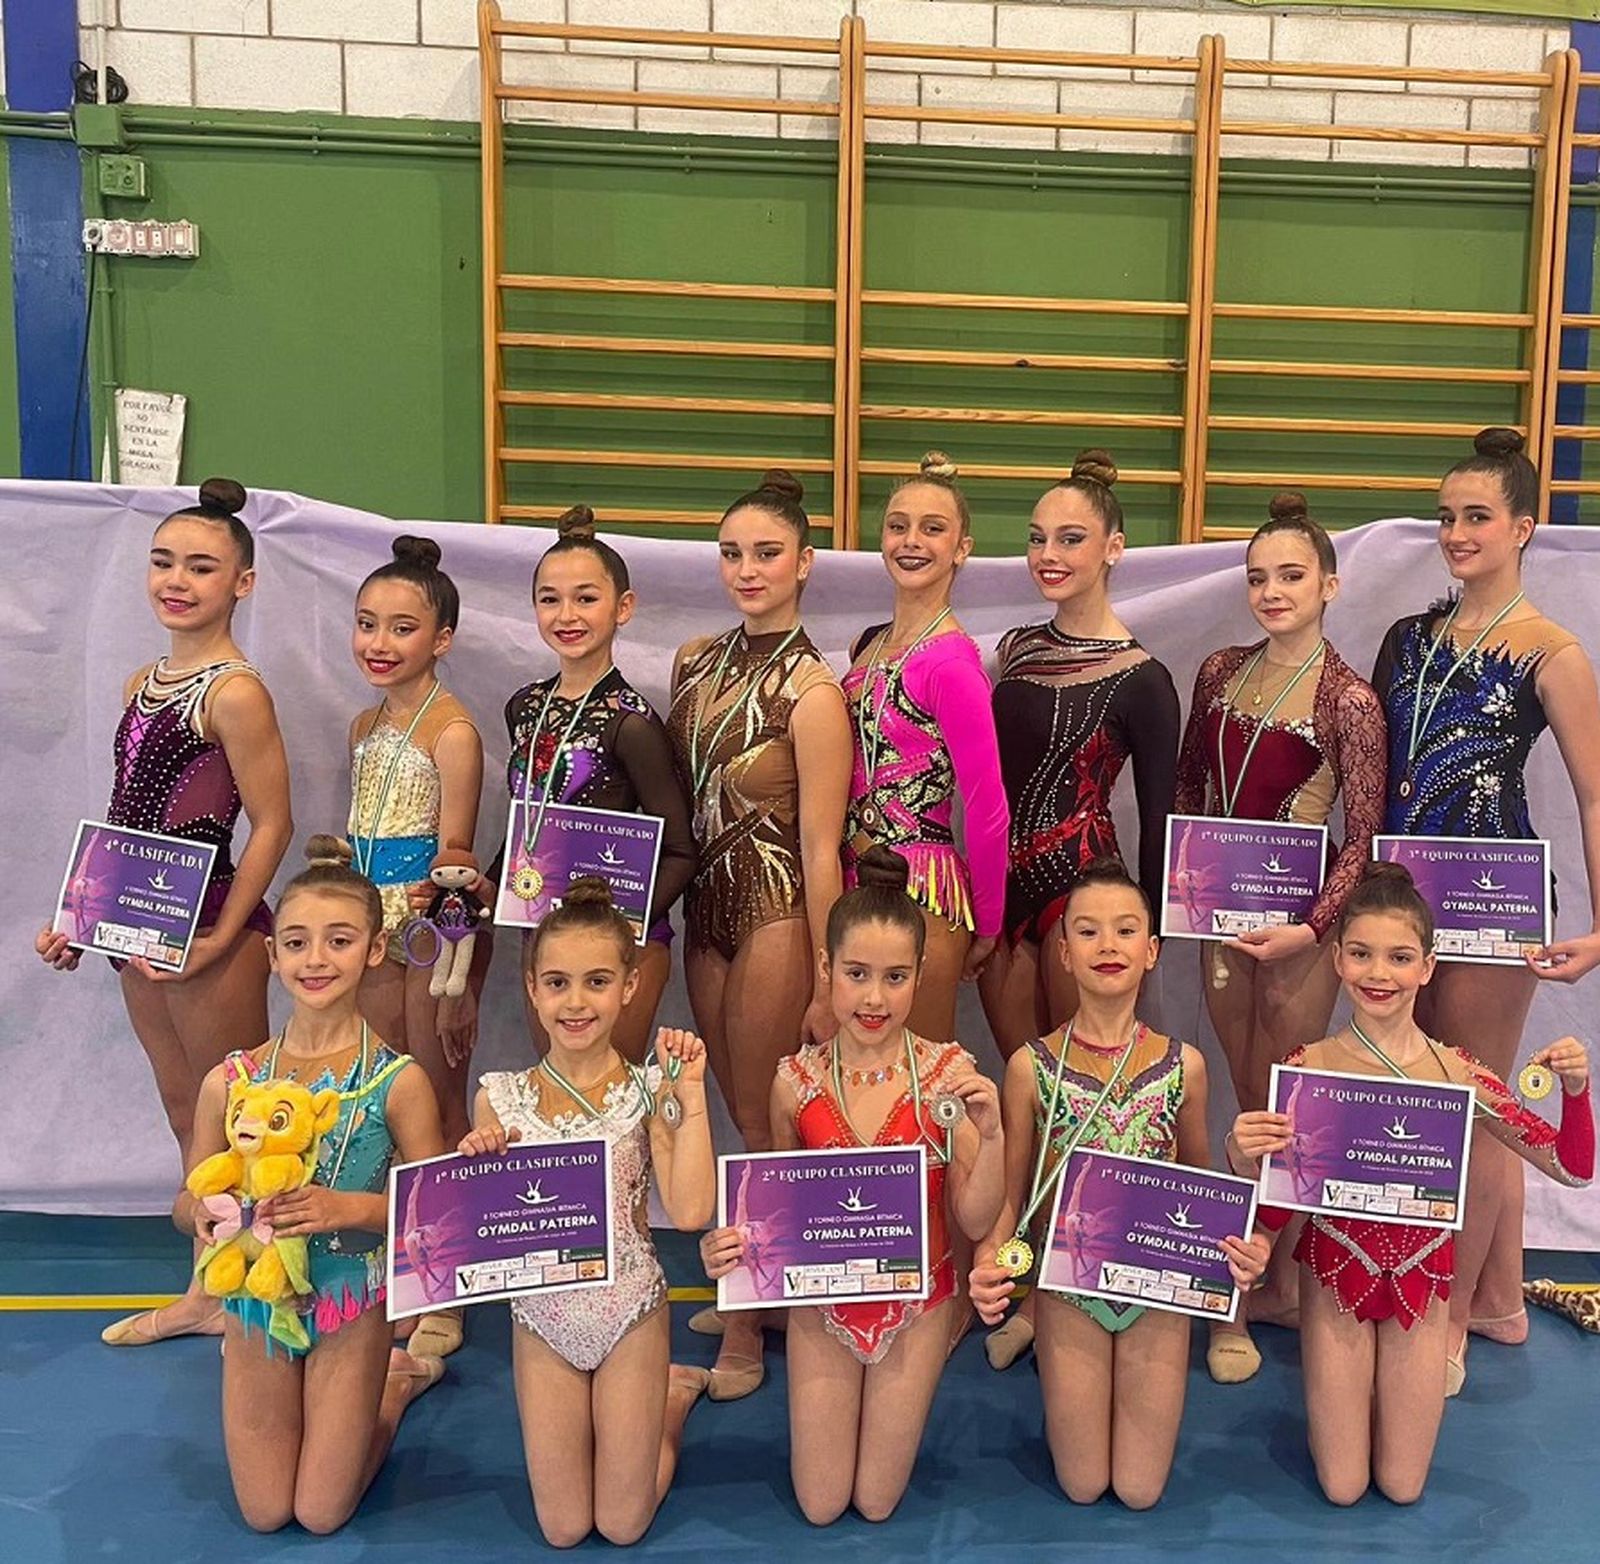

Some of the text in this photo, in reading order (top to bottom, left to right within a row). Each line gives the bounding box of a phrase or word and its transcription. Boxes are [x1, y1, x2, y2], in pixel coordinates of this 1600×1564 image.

[555, 819, 592, 832] EQUIPO
[594, 823, 654, 840] CLASIFICADO
[1214, 832, 1253, 843] EQUIPO
[1255, 835, 1318, 848] CLASIFICADO
[121, 842, 204, 870] CLASIFICADA
[1422, 850, 1463, 863] EQUIPO
[1465, 852, 1539, 864] CLASIFICADO
[609, 876, 645, 892] PATERNA
[1276, 885, 1314, 897] PATERNA
[1442, 900, 1538, 914] GYMDAL PATERNA
[1329, 1088, 1376, 1104] EQUIPO
[1378, 1094, 1462, 1112] CLASIFICADO
[451, 1161, 503, 1181] EQUIPO
[506, 1153, 598, 1173] CLASIFICADO
[1346, 1149, 1453, 1169] GYMDAL PATERNA
[779, 1168, 827, 1183] EQUIPO
[830, 1164, 915, 1179] CLASIFICADO
[1115, 1170, 1161, 1188] EQUIPO
[1163, 1180, 1244, 1205] CLASIFICADO
[477, 1221, 536, 1238] GYMDAL
[539, 1214, 598, 1230] PATERNA
[803, 1225, 914, 1241] GYMDAL PATERNA
[1126, 1232, 1178, 1251] GYMDAL
